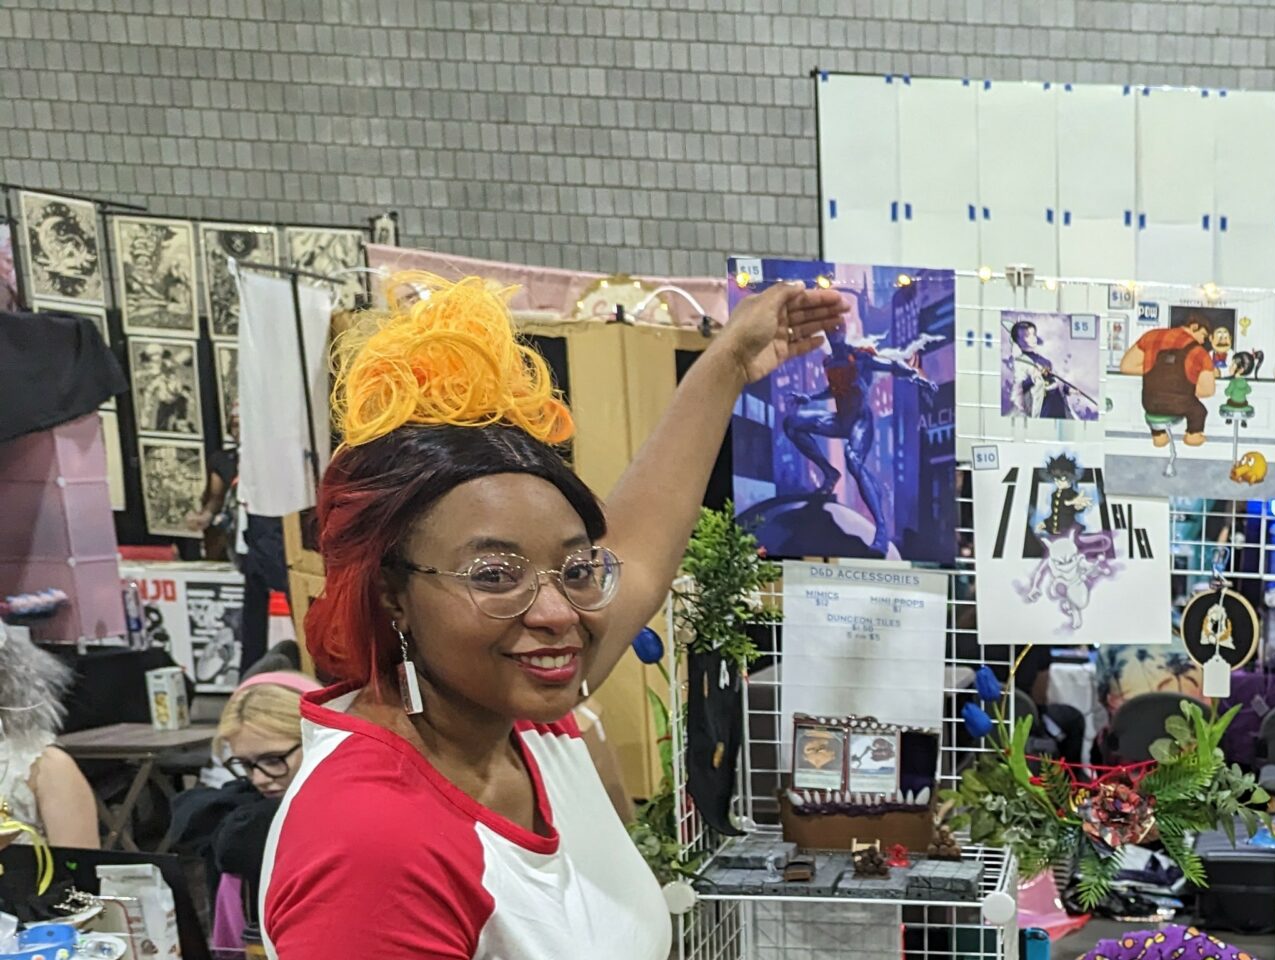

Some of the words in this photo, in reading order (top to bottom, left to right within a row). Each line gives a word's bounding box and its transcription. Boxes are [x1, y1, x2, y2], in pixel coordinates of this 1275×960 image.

[1073, 320, 1089, 332] $5
[976, 452, 996, 463] $10
[838, 568, 920, 585] ACCESSORIES
[806, 590, 840, 600] MIMICS
[893, 598, 925, 609] PROPS
[827, 613, 873, 625] DUNGEON
[876, 618, 901, 628] TILES
